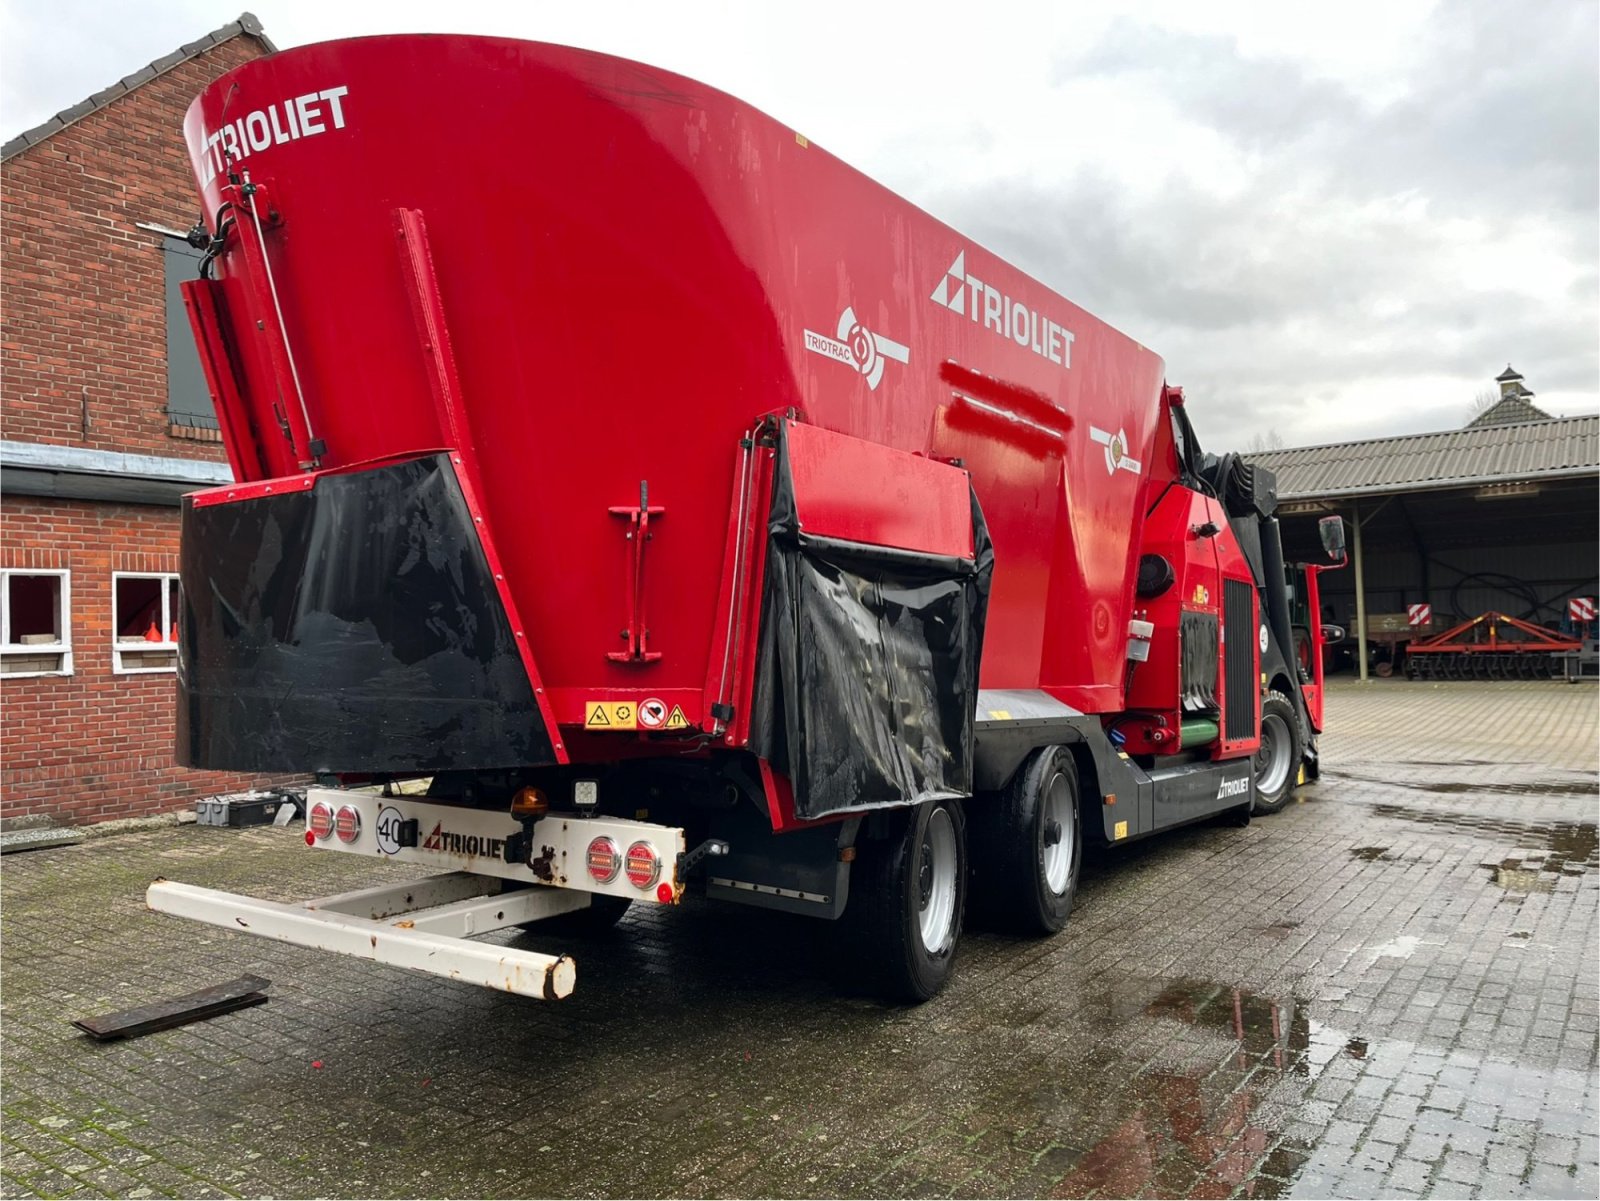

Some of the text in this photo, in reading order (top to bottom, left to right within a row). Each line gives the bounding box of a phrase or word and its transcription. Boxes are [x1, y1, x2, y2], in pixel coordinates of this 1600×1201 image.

[208, 85, 348, 174] TRIOLIET
[806, 334, 850, 360] TRIOTRAC
[966, 273, 1075, 369] TRIOLIET
[379, 817, 402, 843] 40
